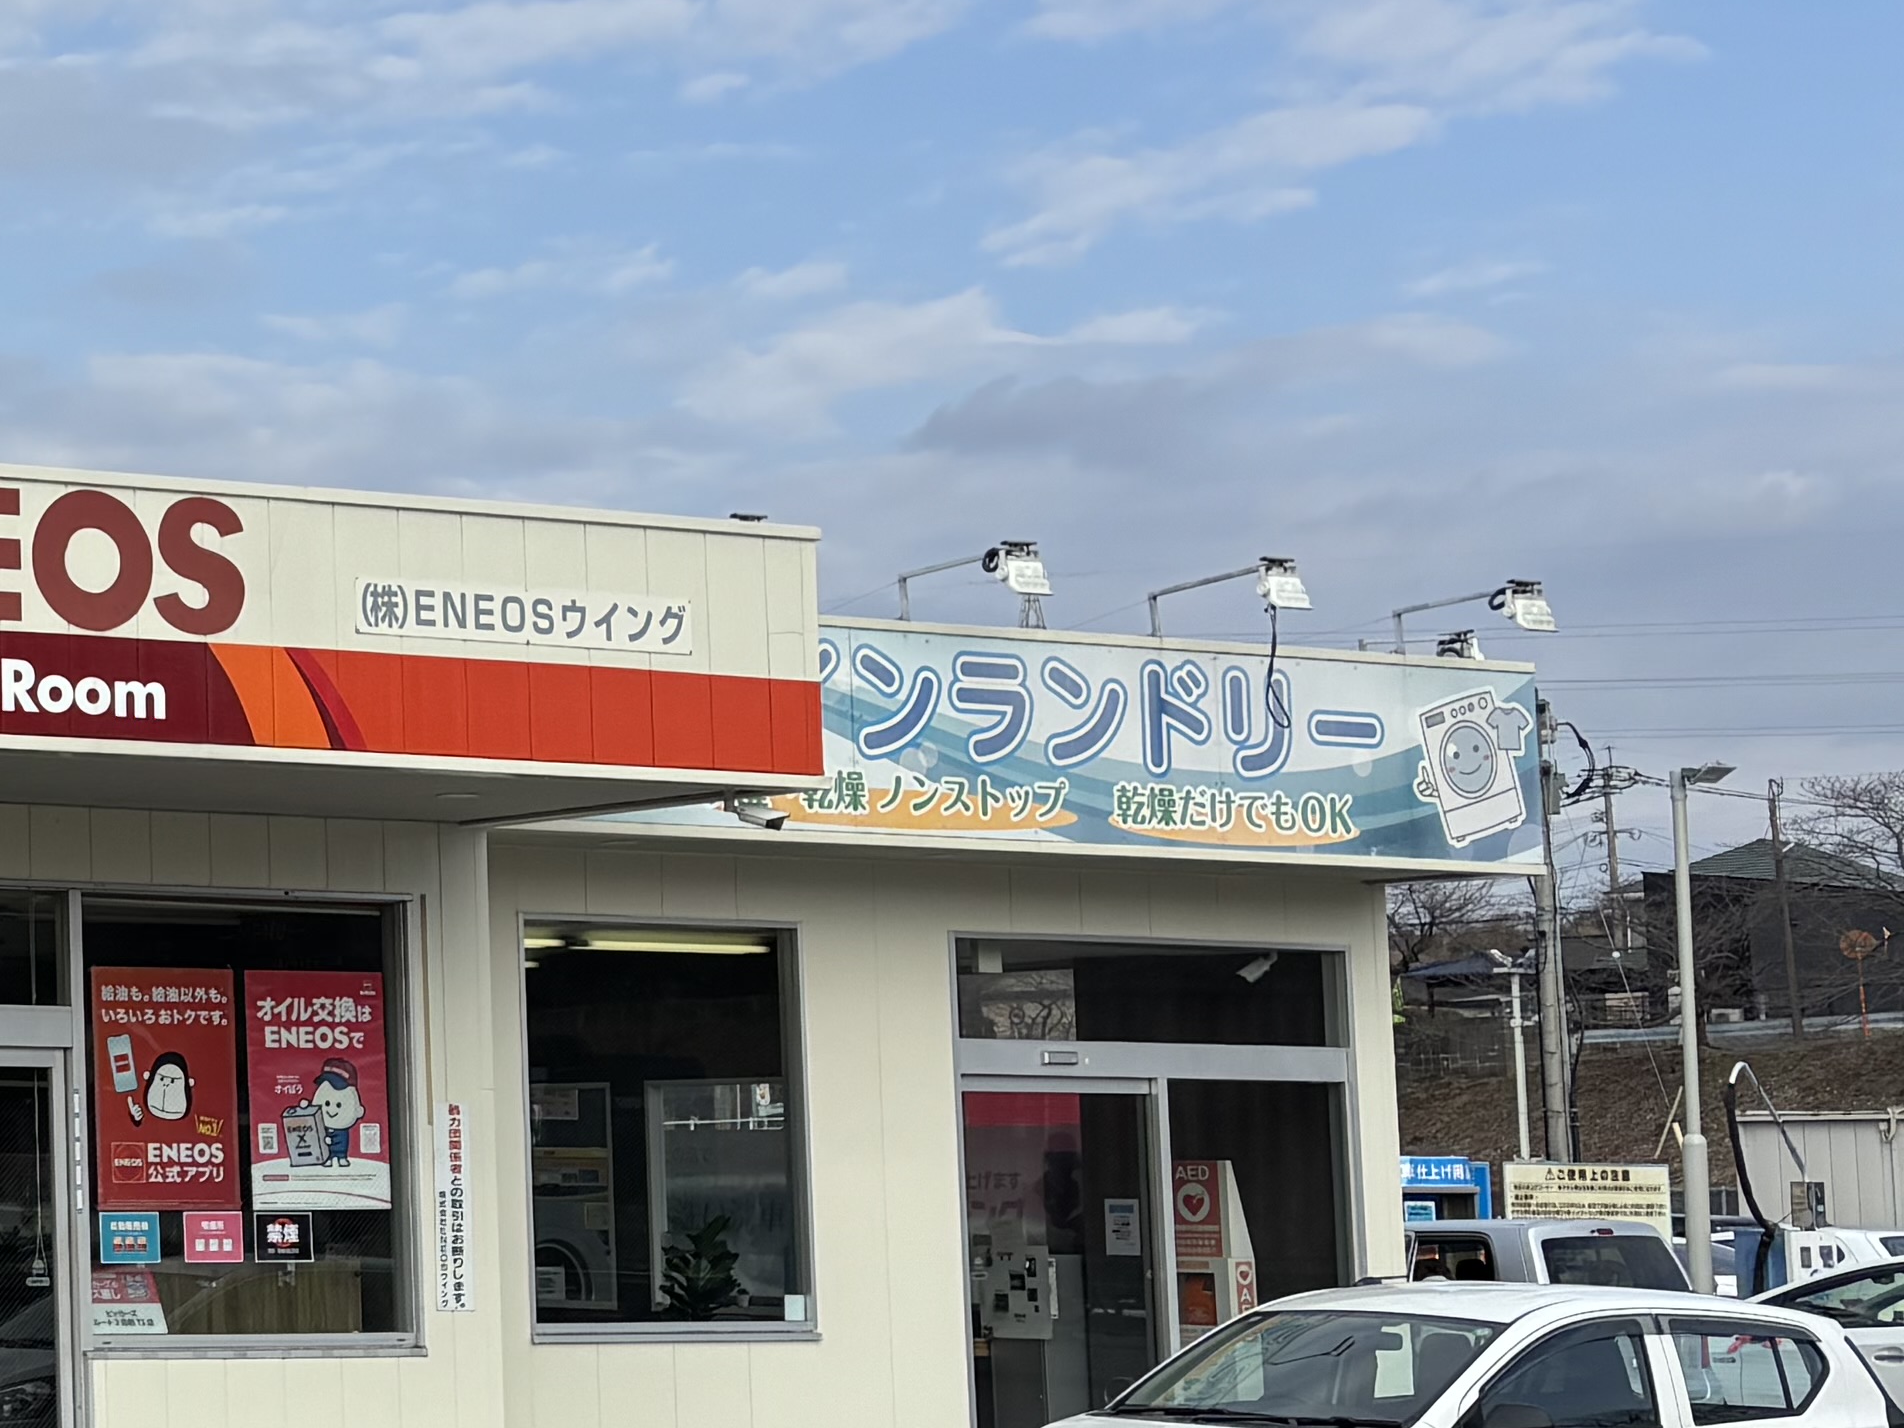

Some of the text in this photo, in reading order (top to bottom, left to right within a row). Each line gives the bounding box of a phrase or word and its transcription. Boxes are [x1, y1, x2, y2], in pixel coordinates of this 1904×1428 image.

[359, 578, 688, 646] (株)ENEOSウイング
[0, 657, 168, 720] Room
[820, 637, 1384, 778] ンランドリー
[1114, 782, 1355, 838] 乾燥だけでもOK
[101, 985, 227, 1004] 給油も。給油以外も。
[101, 1008, 228, 1026] いろいろおトクです。
[256, 997, 372, 1023] オイル交換は
[264, 1026, 364, 1049] ENEOSで
[147, 1142, 224, 1164] ENEOS
[147, 1165, 224, 1183] 公式アプリ
[1175, 1165, 1209, 1181] AED
